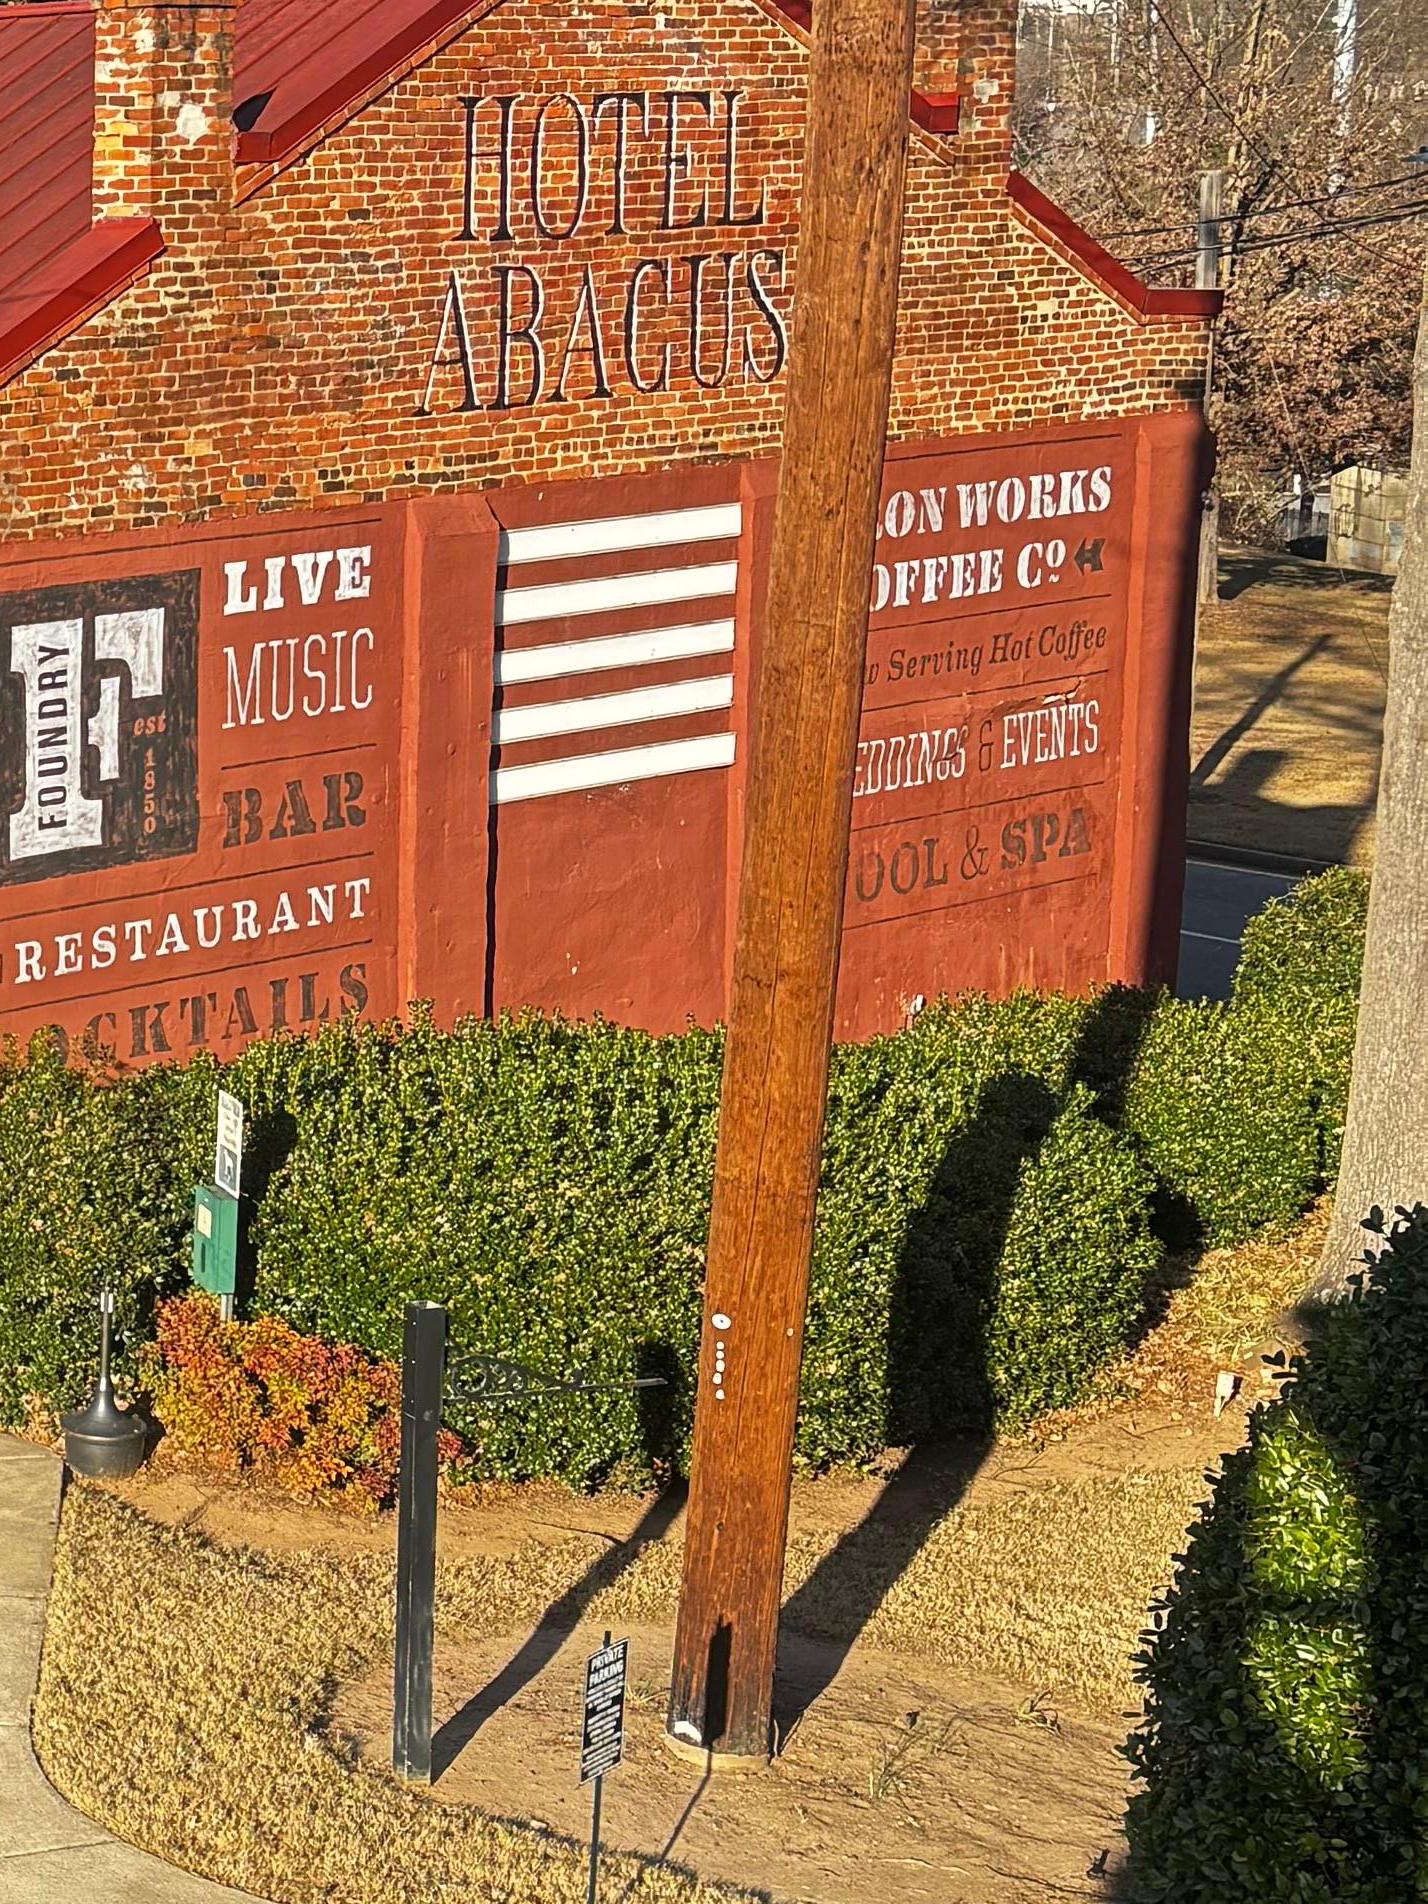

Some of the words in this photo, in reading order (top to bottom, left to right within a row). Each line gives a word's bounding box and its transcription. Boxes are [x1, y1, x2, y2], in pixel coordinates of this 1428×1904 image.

[449, 91, 767, 242] HOTEL
[412, 249, 790, 417] ABACUS
[875, 486, 947, 542] ON
[955, 466, 1112, 528] WORKS
[223, 545, 372, 616] LIVE
[869, 548, 1004, 613] OFFEE
[221, 627, 375, 730] MUSIC
[887, 641, 984, 682] Serving
[988, 629, 1032, 664] Hot
[1038, 620, 1107, 662] Coffee
[37, 645, 70, 831] FOUNDRY
[133, 710, 166, 737] est
[853, 724, 969, 798] EDDINGS
[1000, 699, 1100, 769] EVENTS
[142, 749, 157, 834] 1850
[223, 771, 367, 849] BAR
[855, 838, 948, 903] OOL
[959, 824, 990, 881] &
[1000, 807, 1092, 871] SPA
[13, 877, 371, 986] RESTAURANT
[27, 963, 369, 1068] OCKTAILS
